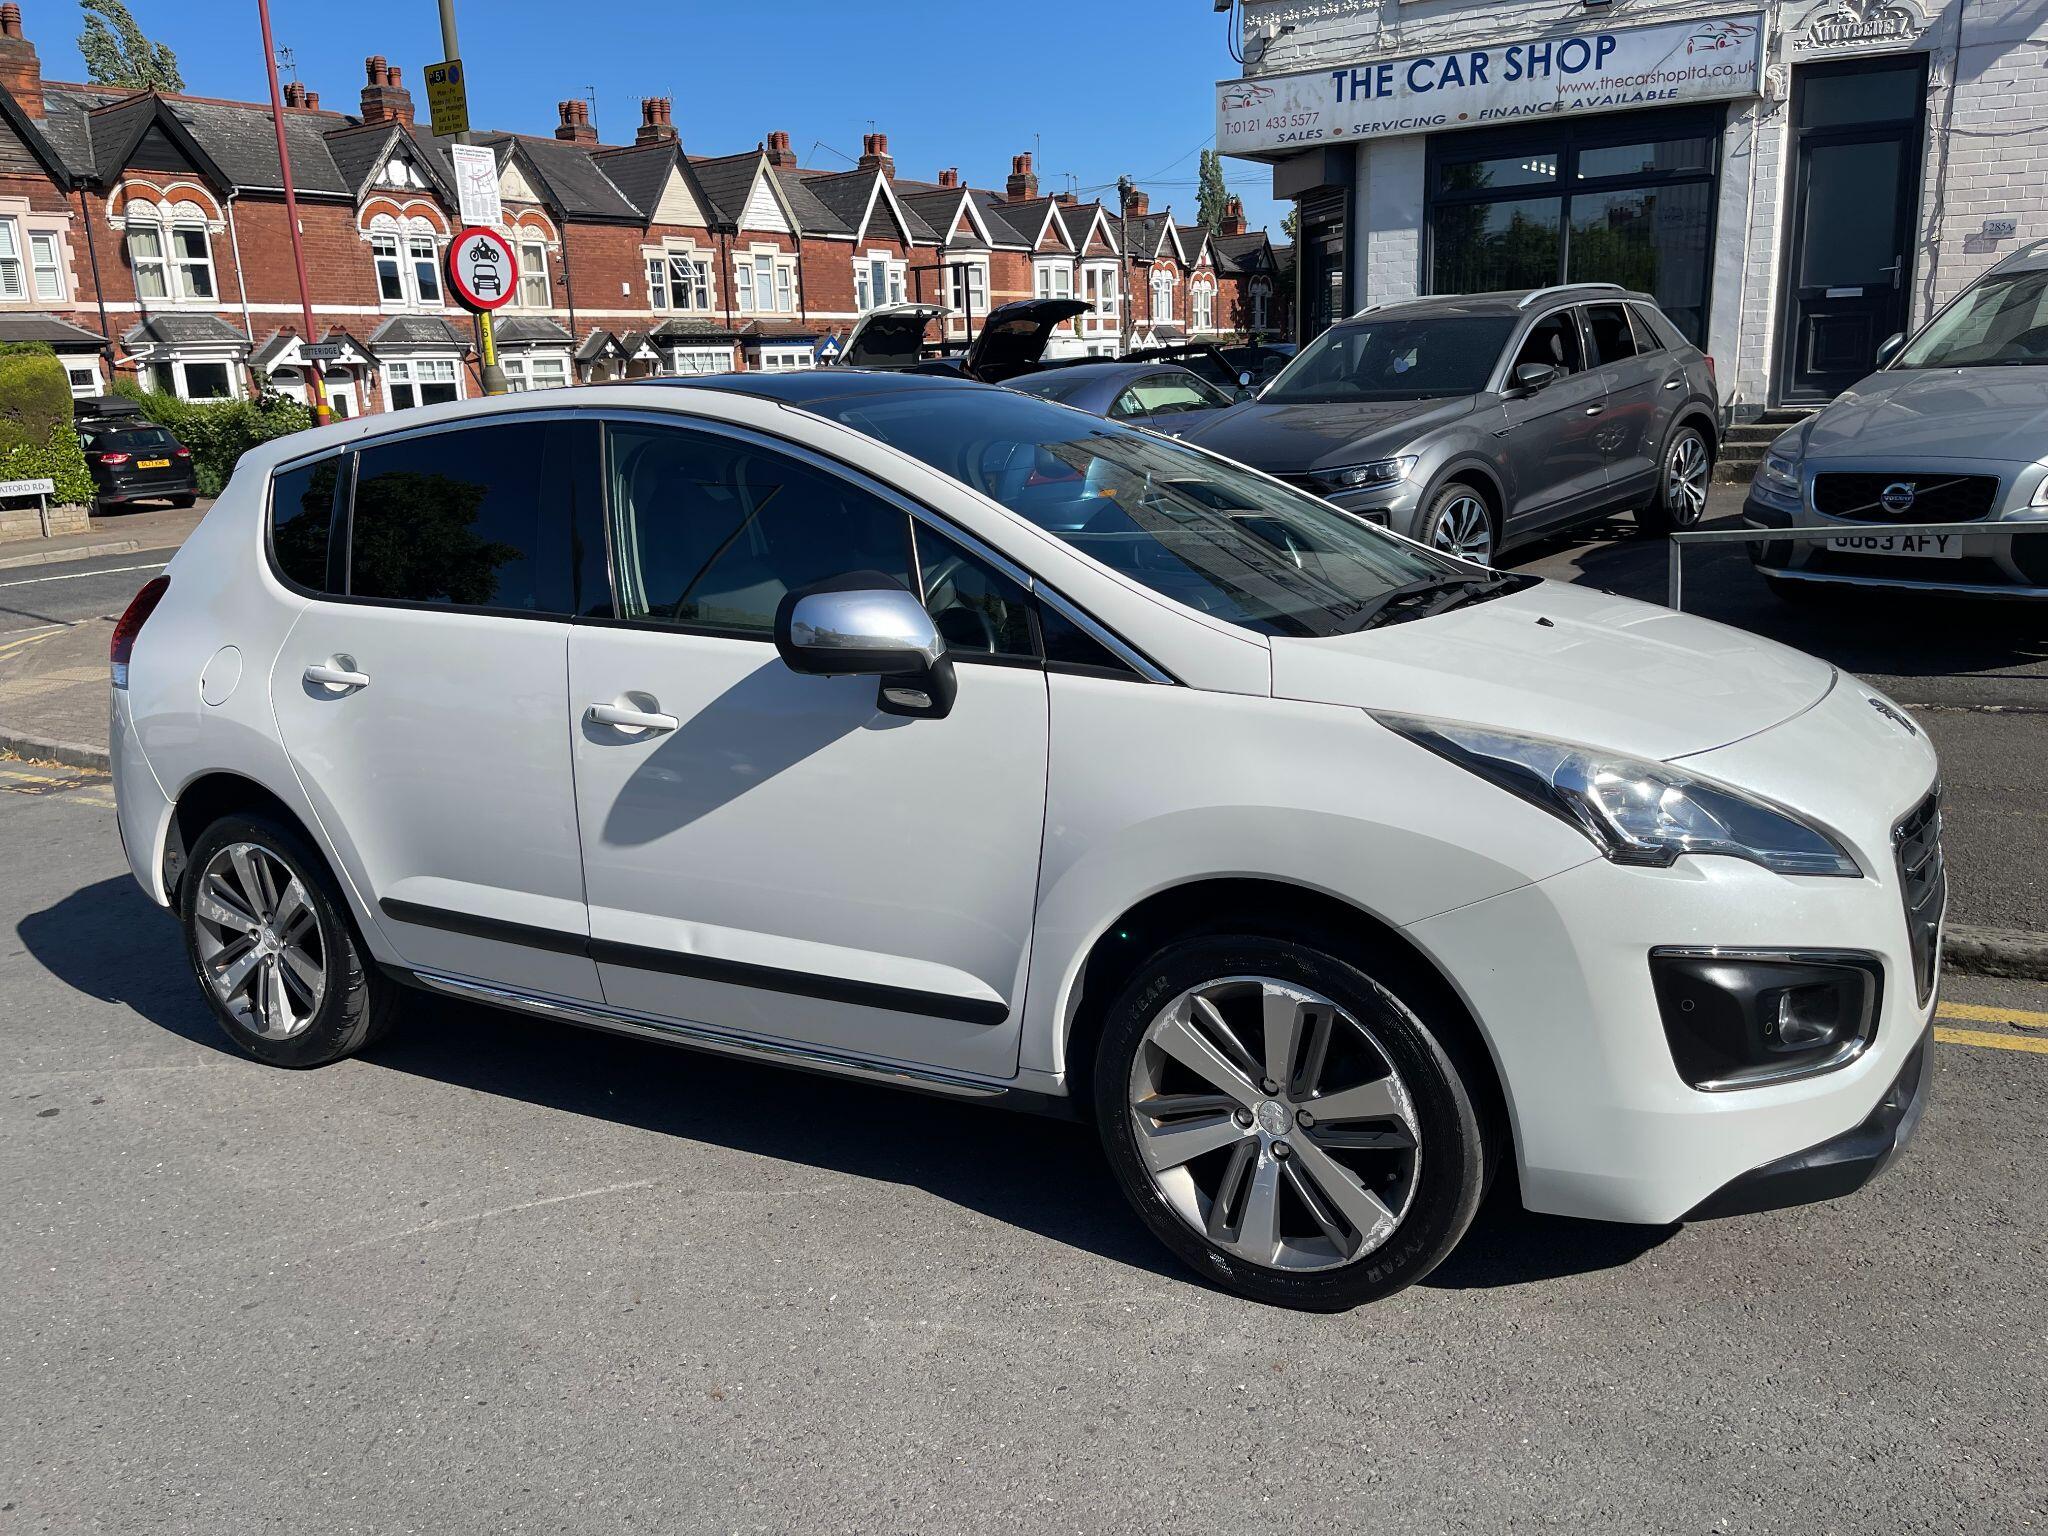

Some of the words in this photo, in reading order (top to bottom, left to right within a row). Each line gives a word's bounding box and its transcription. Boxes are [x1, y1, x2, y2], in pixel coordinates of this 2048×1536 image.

[1332, 64, 1394, 103] THE
[1407, 52, 1490, 93] CAR
[1503, 35, 1617, 82] SHOP
[1556, 60, 1758, 95] www.thecarshopltd.co.uk
[1225, 119, 1260, 135] T:0121
[1266, 116, 1287, 130] 433
[1291, 112, 1320, 128] 5577
[1277, 129, 1323, 143] SALES
[1352, 114, 1447, 135] SERVICING
[1479, 100, 1565, 120] FINANCE
[1570, 88, 1679, 110] AVAILABLE
[33, 483, 45, 491] RD
[1902, 534, 1950, 554] AFY
